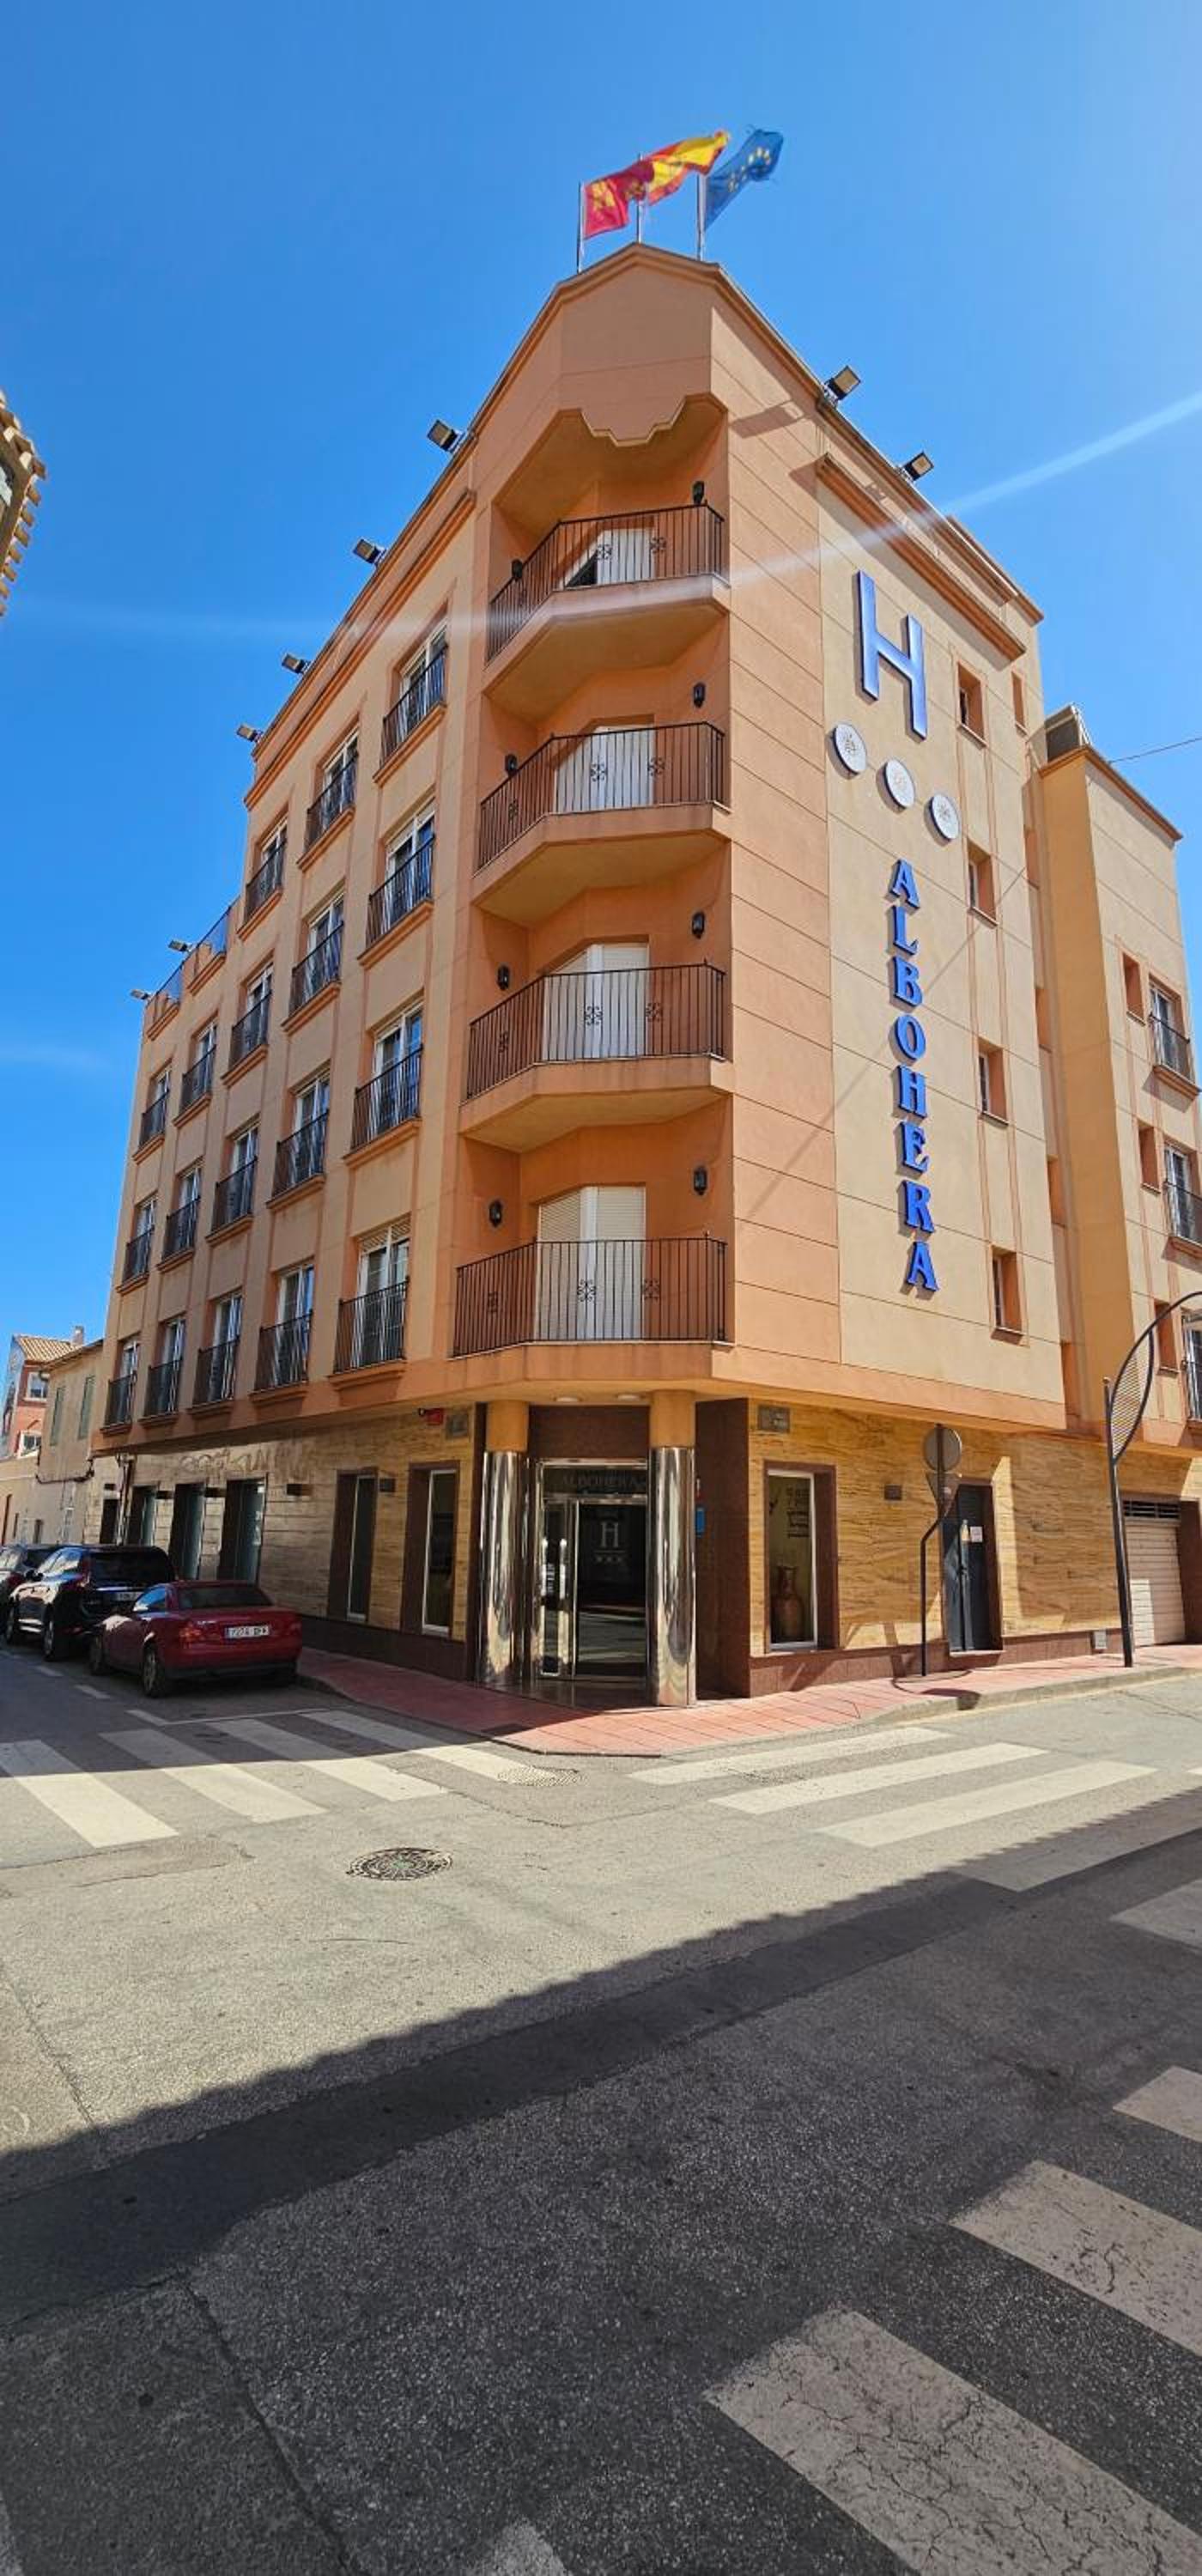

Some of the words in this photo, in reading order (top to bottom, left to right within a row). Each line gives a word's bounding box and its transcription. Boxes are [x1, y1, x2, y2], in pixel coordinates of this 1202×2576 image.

[858, 569, 927, 740] H
[890, 859, 939, 1292] ALBOHERA
[601, 1521, 619, 1547] H
